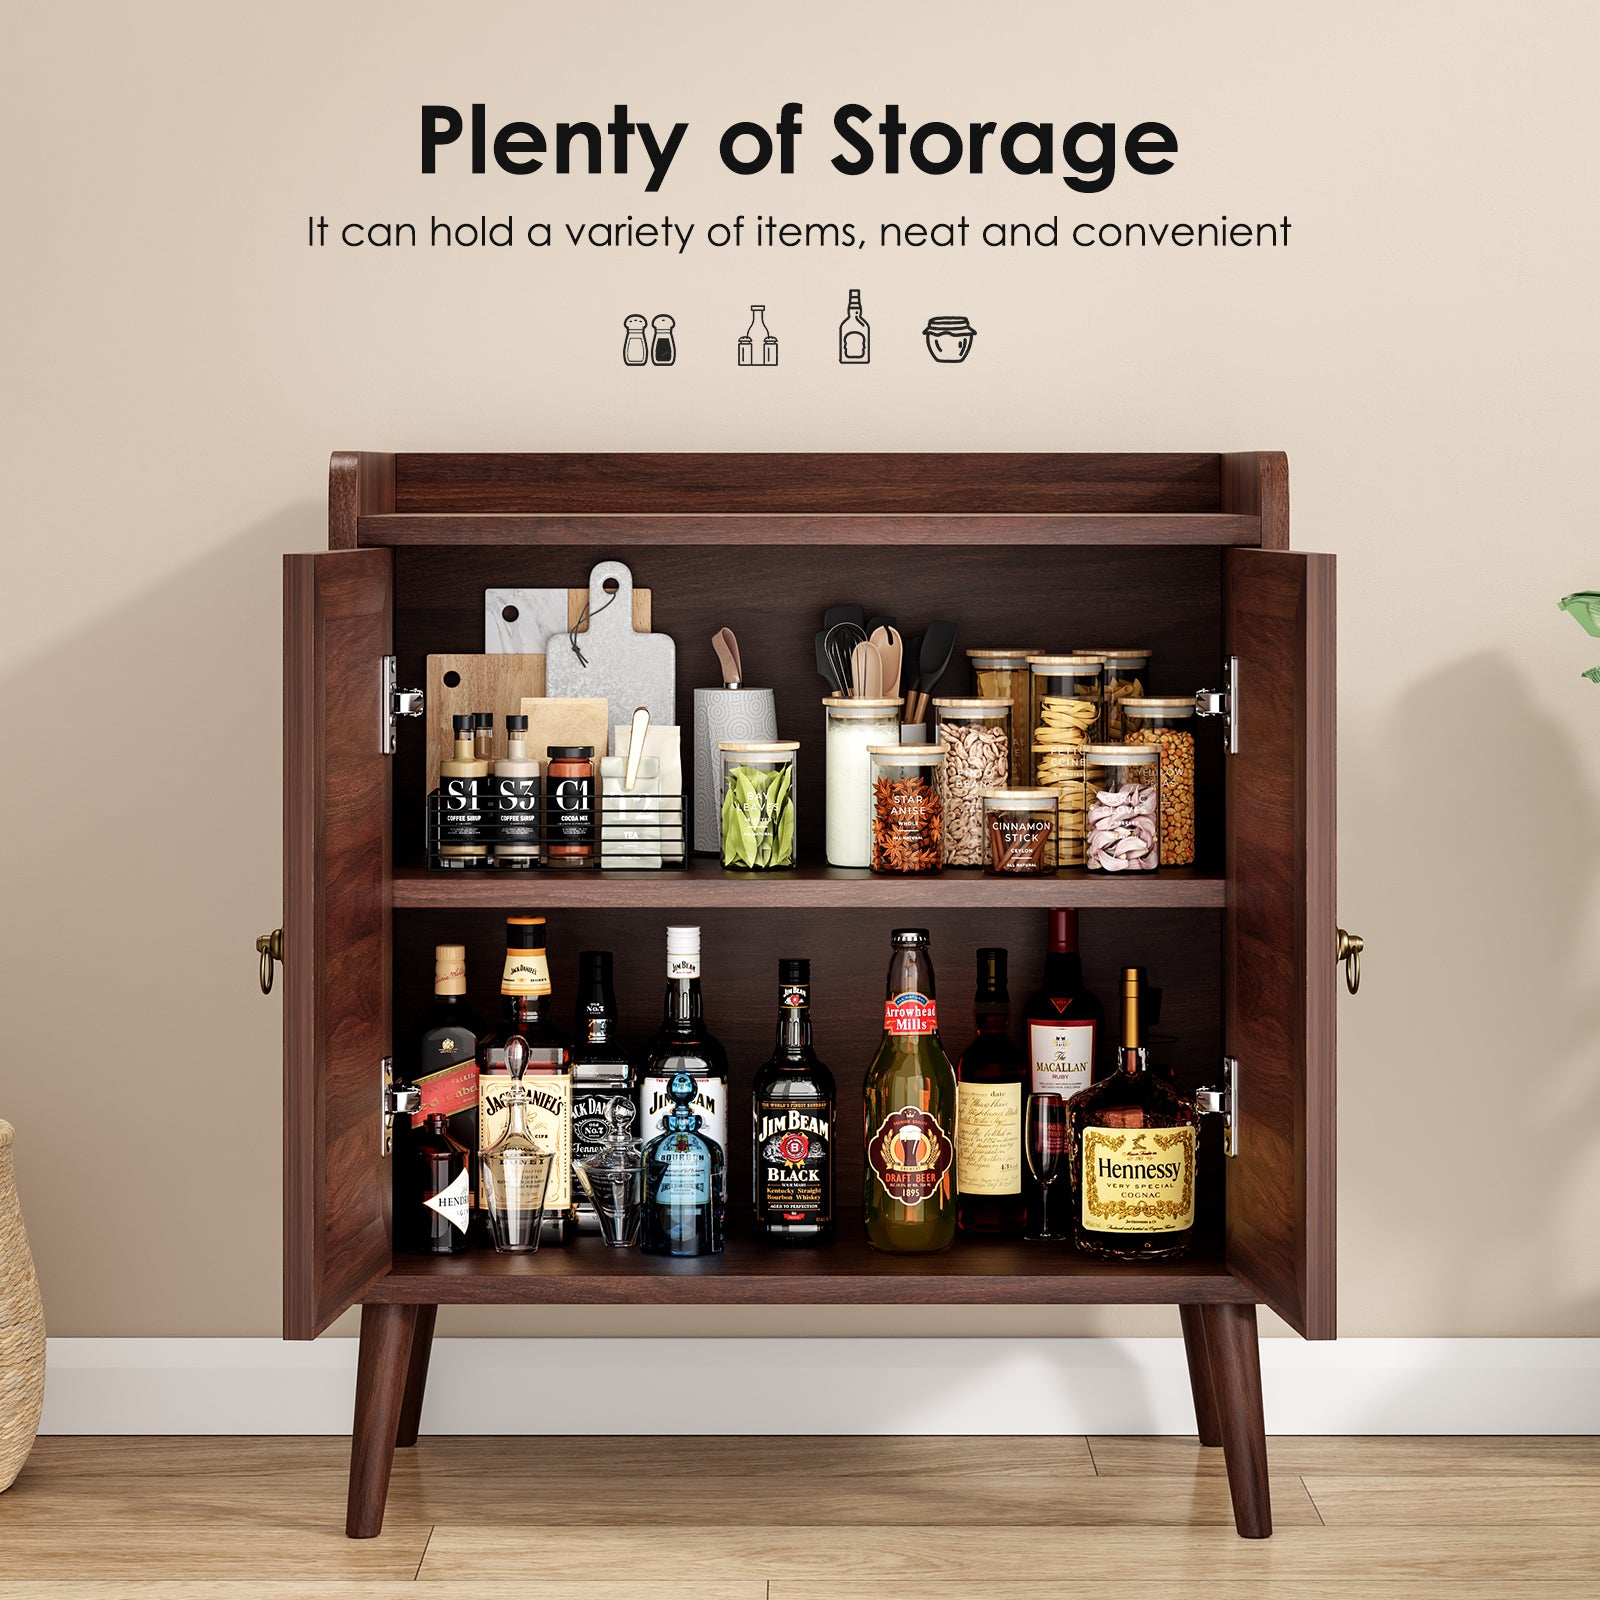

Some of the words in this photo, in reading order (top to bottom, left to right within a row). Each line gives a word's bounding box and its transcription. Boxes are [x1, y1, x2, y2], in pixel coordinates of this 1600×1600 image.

[447, 780, 481, 811] S1
[499, 780, 535, 811] S3
[556, 780, 590, 811] C1
[747, 792, 768, 800] BAY
[894, 795, 924, 804] STAR
[738, 803, 779, 811] LEAVES
[890, 807, 927, 815] ANISE
[1102, 806, 1148, 815] CLOVES
[992, 822, 1051, 831] CINNAMON
[624, 831, 638, 840] TEA
[1005, 833, 1040, 842] STICK
[886, 1005, 936, 1018] Arrowhead
[896, 1018, 927, 1031] Mills
[1054, 1051, 1067, 1062] The
[1036, 1062, 1088, 1073] MACALLAN
[526, 1089, 564, 1116] ANIEL'S
[758, 1115, 787, 1143] JIM
[788, 1109, 830, 1142] BEAM
[1098, 1157, 1182, 1182] Hennessy
[767, 1167, 821, 1182] BLACK
[885, 1173, 912, 1183] DRAFT
[915, 1173, 937, 1183] BEER
[1106, 1182, 1131, 1190] VERY
[1134, 1182, 1175, 1190] SPECIAL
[767, 1187, 795, 1196] Kentucky
[797, 1187, 822, 1195] Straight
[902, 1188, 920, 1197] 1895
[1120, 1191, 1162, 1199] COGNAC
